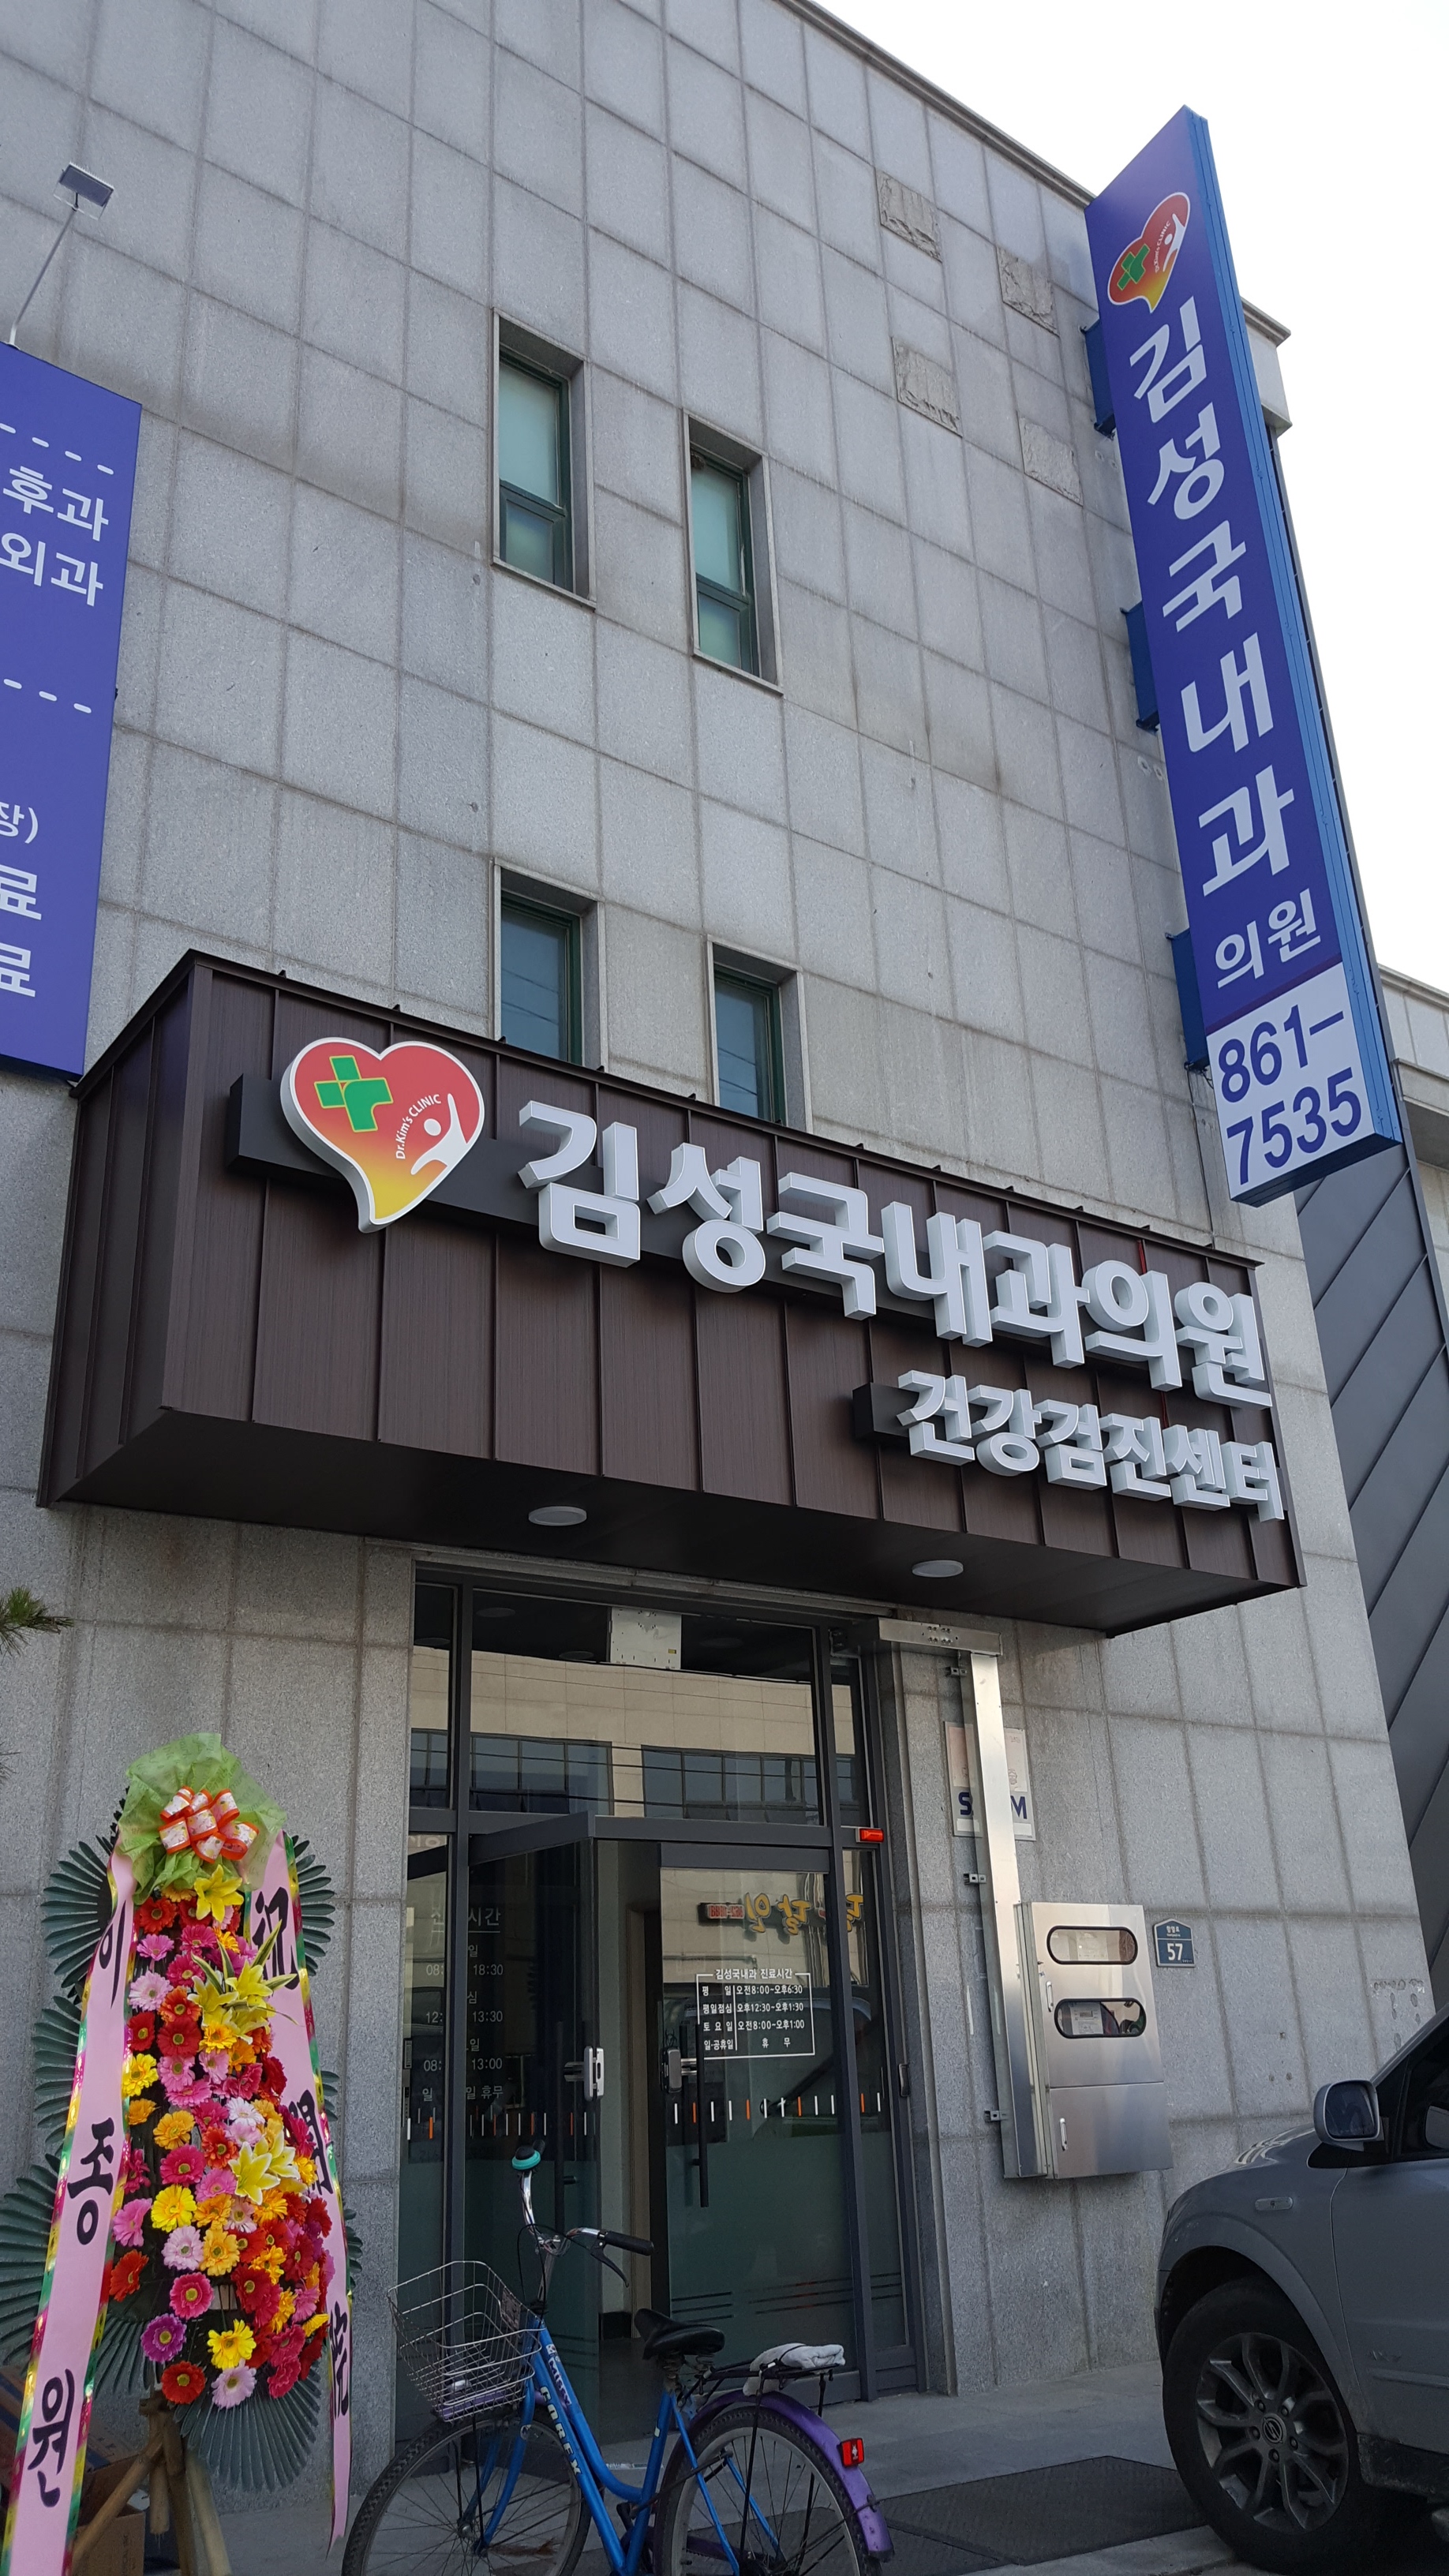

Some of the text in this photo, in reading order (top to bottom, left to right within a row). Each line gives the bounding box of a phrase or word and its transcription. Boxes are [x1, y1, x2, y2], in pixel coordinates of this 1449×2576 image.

[1129, 295, 1295, 897] 김성국내과
[1214, 888, 1321, 989] 의원
[395, 1094, 442, 1159] Dr.Kim's CLINIC
[1226, 1066, 1362, 1186] 7535
[1167, 1942, 1183, 1961] 57
[474, 1964, 504, 1975] 18:30
[715, 1968, 793, 1980] 김성국내과 진료시간
[473, 2010, 504, 2023] 13:30
[471, 2057, 503, 2070] 13:00
